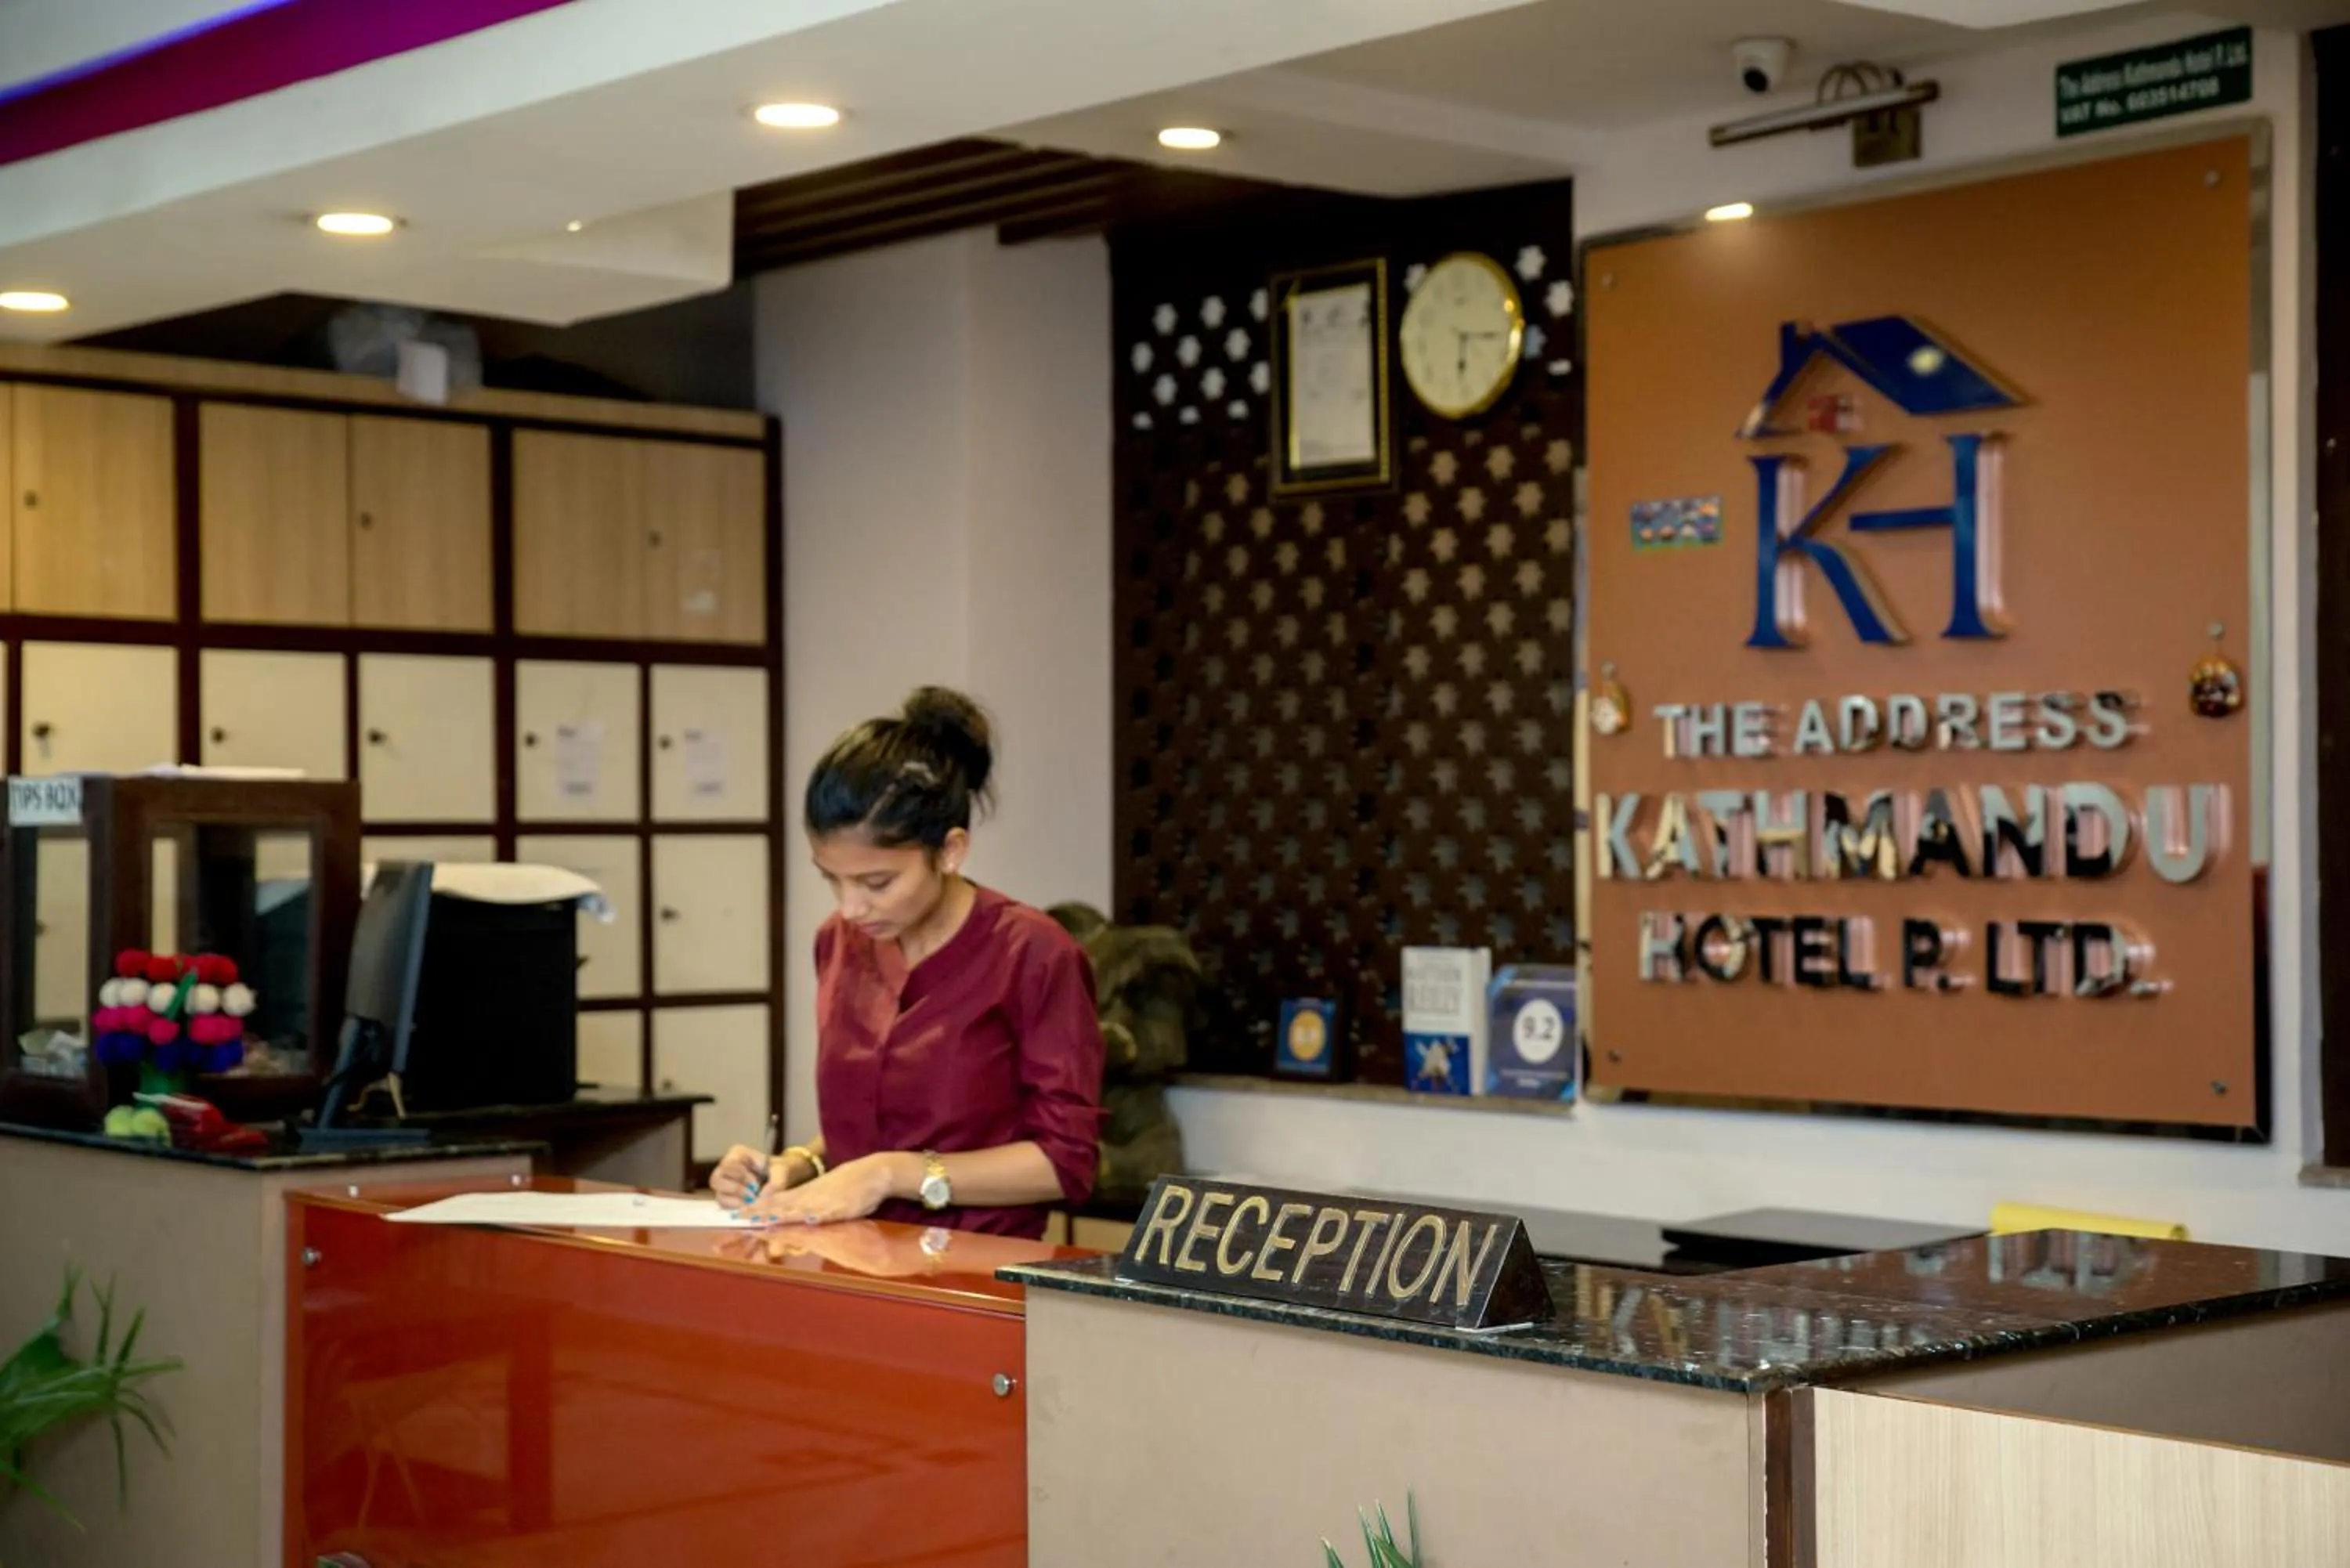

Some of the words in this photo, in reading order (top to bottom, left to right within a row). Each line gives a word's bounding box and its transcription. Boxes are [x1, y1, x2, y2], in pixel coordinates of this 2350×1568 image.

[1654, 702, 1773, 760] THE
[1793, 690, 2135, 756] ADDRESS
[1593, 782, 2225, 884] KATHMANDU
[1638, 910, 1878, 992] HOTEL
[1902, 916, 1958, 991] P.
[1986, 919, 2166, 998] LTD.
[1522, 1015, 1556, 1042] 9.2
[1134, 1184, 1499, 1306] RECEPTION
